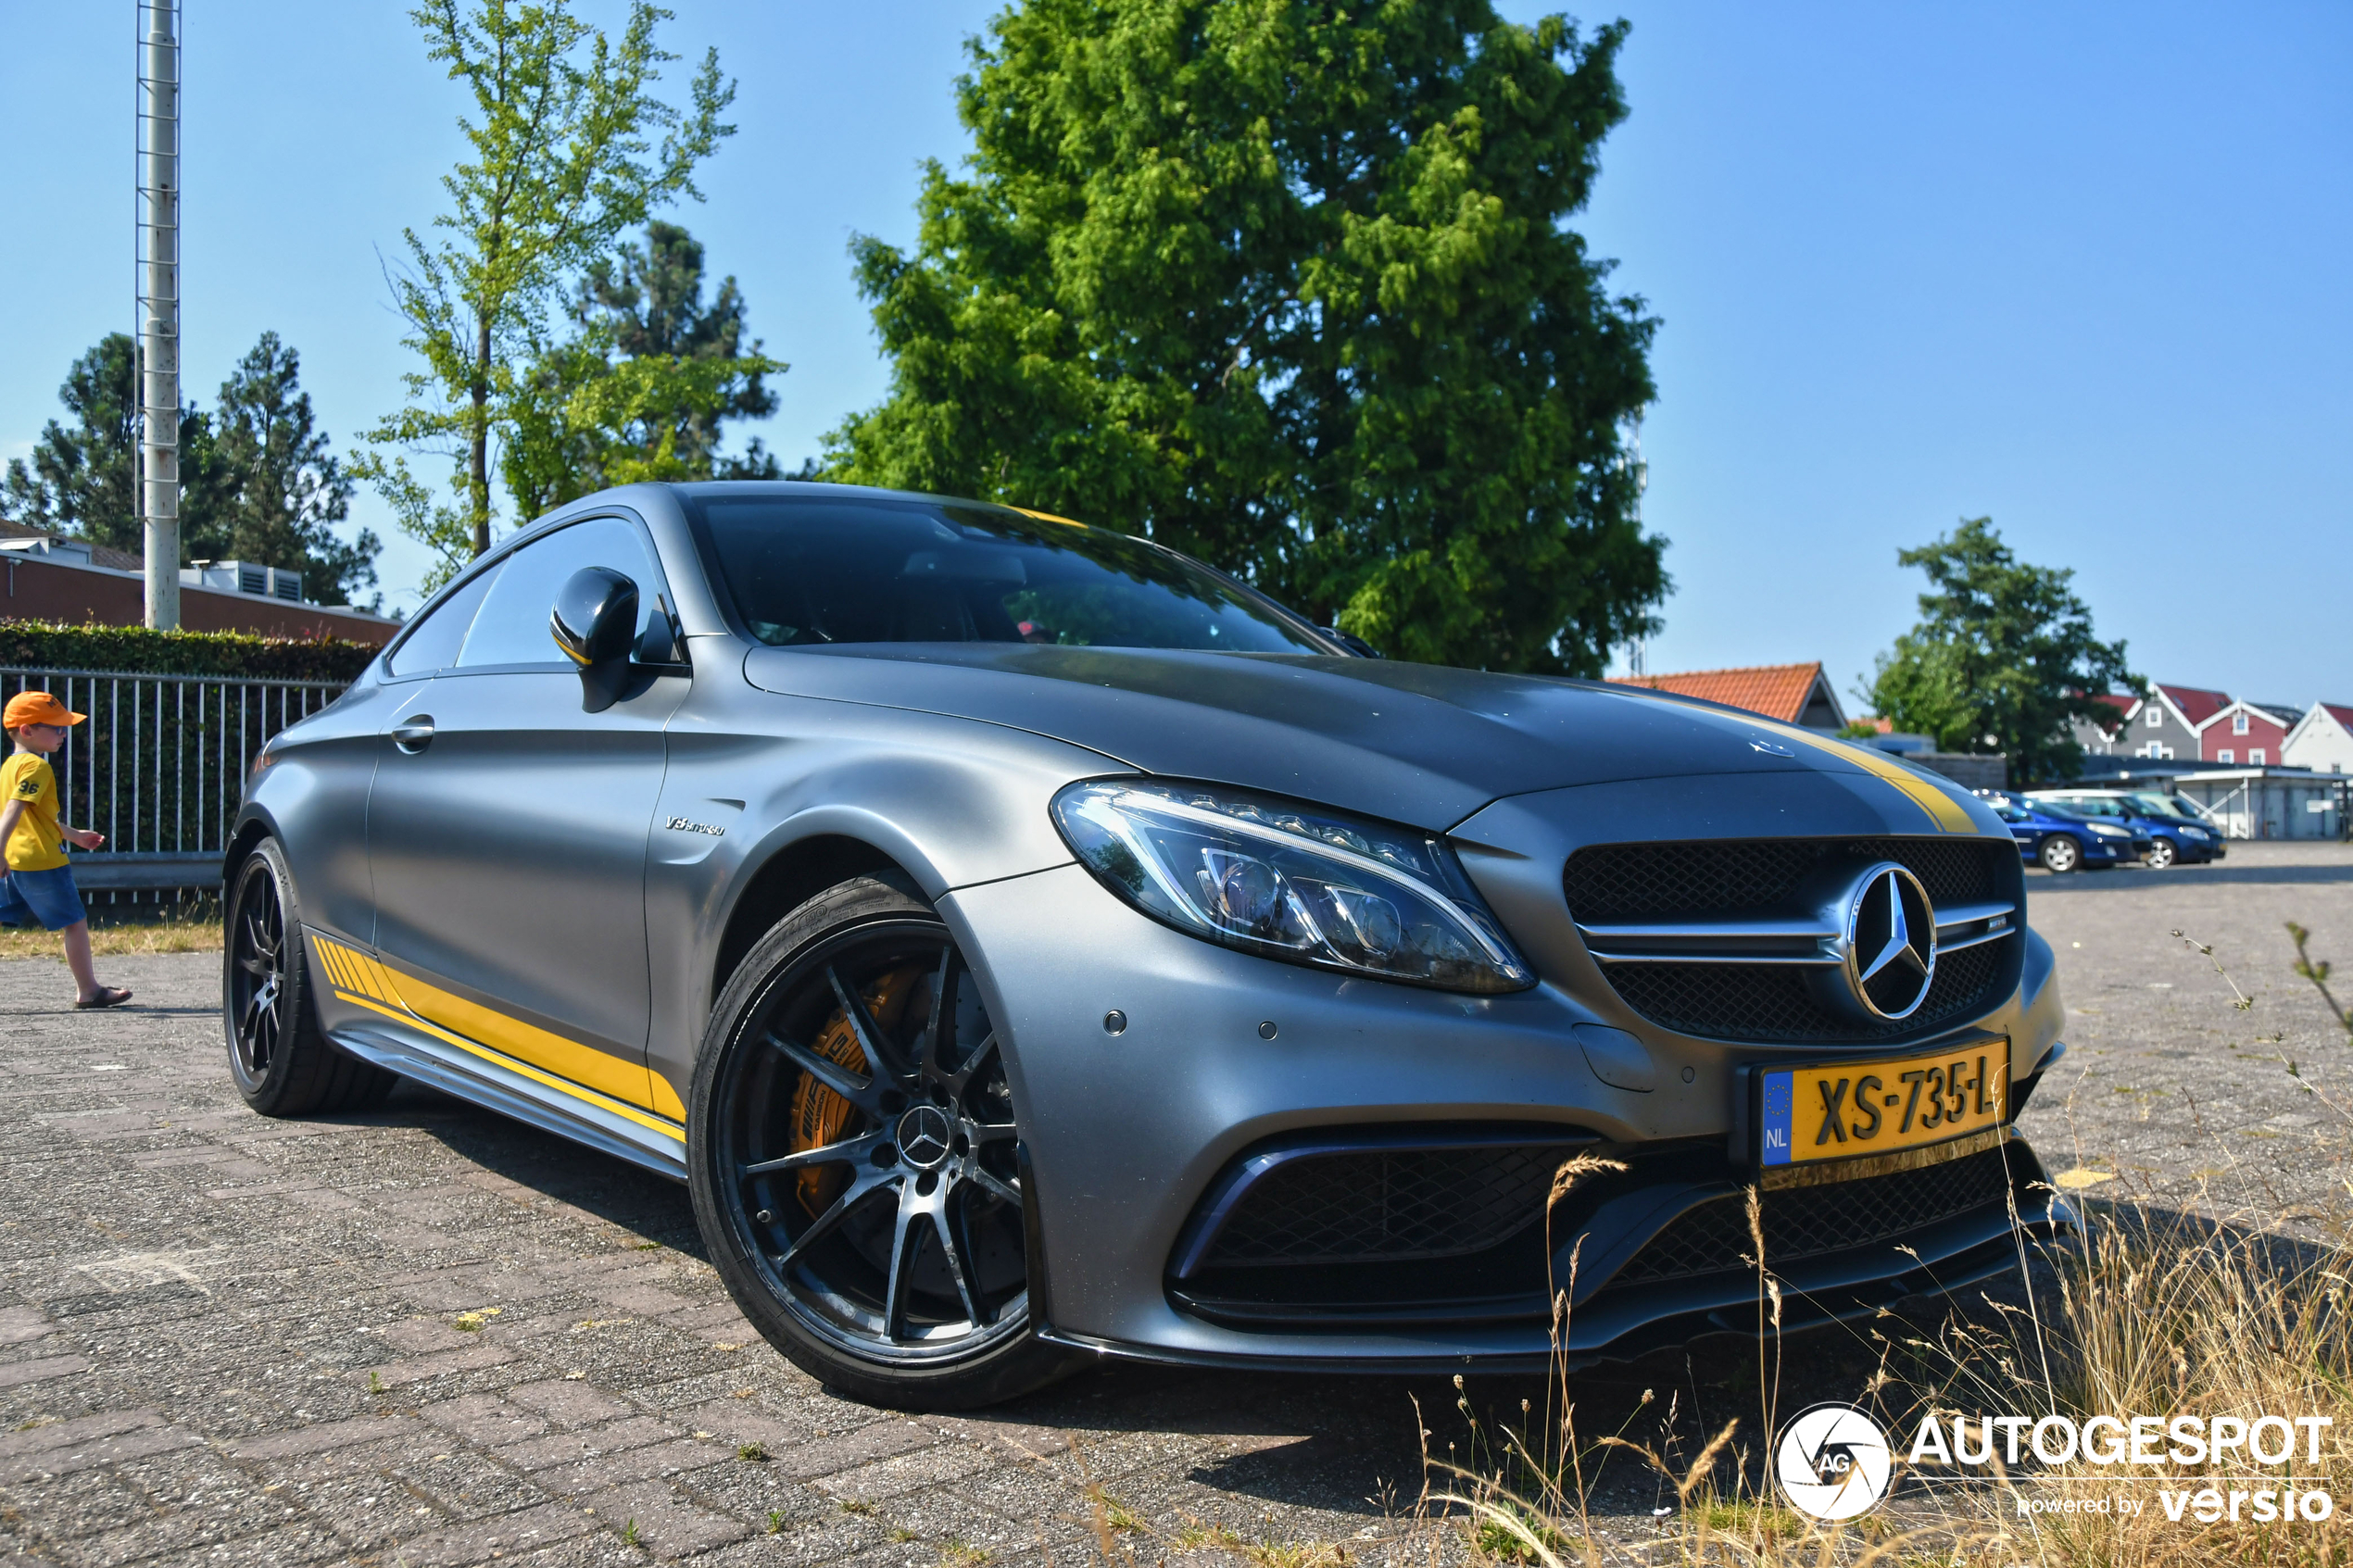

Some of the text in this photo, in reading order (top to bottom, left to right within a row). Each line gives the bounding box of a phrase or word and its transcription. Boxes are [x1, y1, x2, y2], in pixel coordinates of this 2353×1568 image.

[19, 781, 40, 795] 36
[666, 816, 688, 830] V8
[815, 1090, 826, 1131] CARBON
[1816, 1056, 1994, 1146] XS-735-L
[1767, 1128, 1787, 1149] NL
